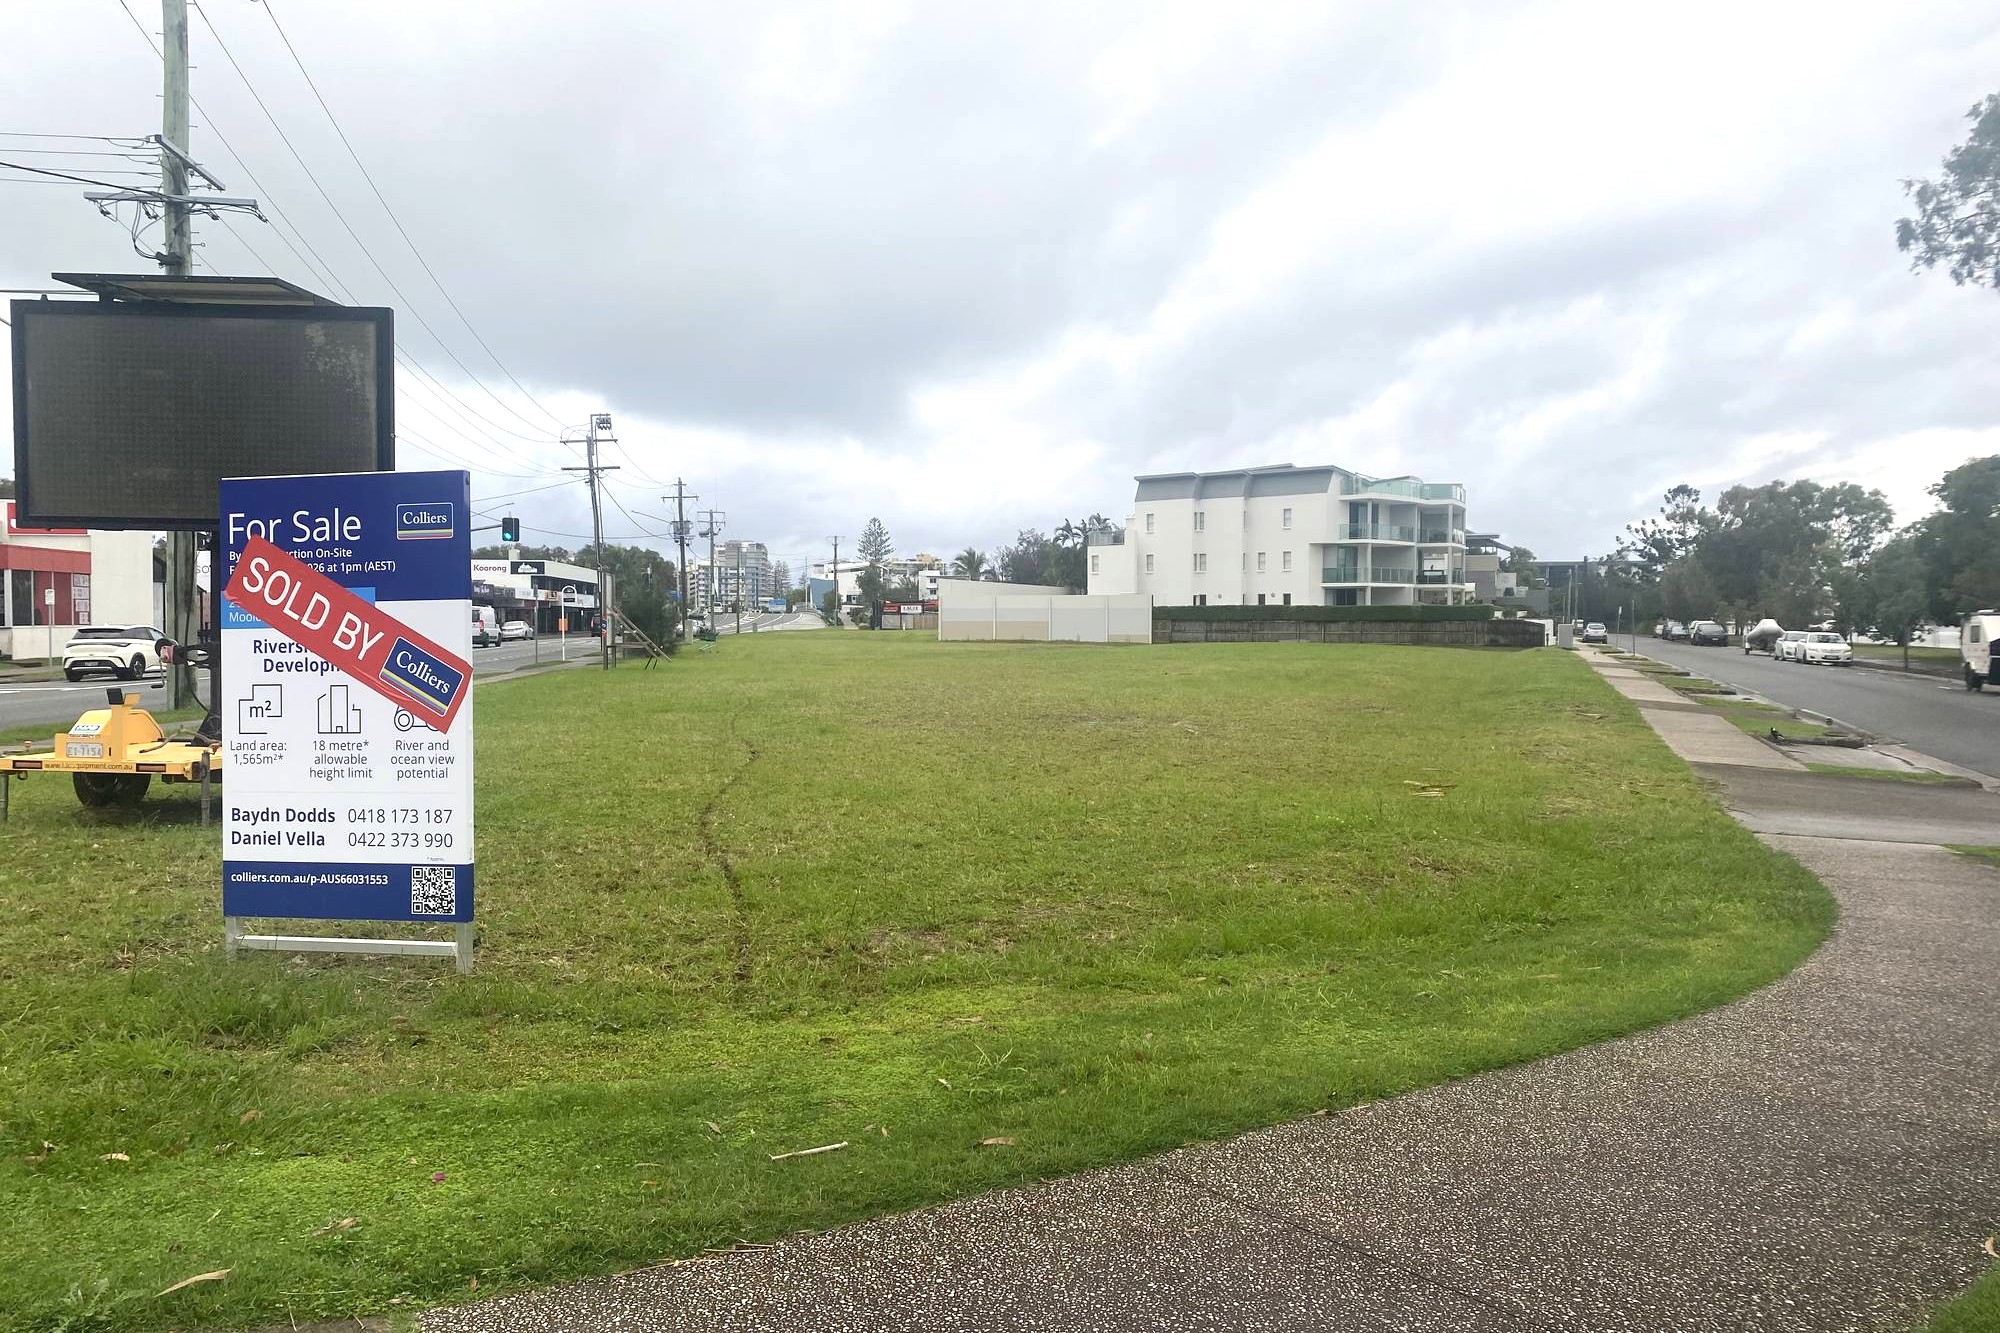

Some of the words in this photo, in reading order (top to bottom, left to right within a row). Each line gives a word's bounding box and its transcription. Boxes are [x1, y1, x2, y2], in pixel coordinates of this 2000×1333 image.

[403, 511, 447, 525] Colliers
[229, 513, 282, 544] For
[292, 508, 361, 542] Sale
[229, 551, 241, 563] By
[316, 548, 353, 558] On-Site
[327, 563, 338, 572] at
[340, 563, 362, 574] 1pm
[365, 561, 396, 573] (AEST)
[473, 564, 507, 573] Koorong
[243, 557, 330, 631] SOLD
[332, 611, 385, 660] BY
[253, 639, 310, 653] Rivers
[263, 657, 340, 676] Develop
[396, 651, 451, 694] Colliers
[230, 740, 257, 751] Land
[259, 742, 287, 751] area:
[312, 740, 326, 751] 18
[395, 740, 424, 751] River
[427, 739, 450, 751] and
[314, 753, 368, 765] allowable
[390, 755, 425, 765] ocean
[428, 754, 455, 765] view
[309, 767, 345, 781] height
[348, 767, 373, 778] limit
[396, 767, 448, 781] potential
[231, 807, 280, 826] Baydn
[285, 808, 335, 823] Dodds
[348, 808, 386, 823] 0418
[391, 809, 419, 823] 173
[424, 809, 453, 824] 187
[231, 831, 281, 845] Daniel
[285, 831, 325, 846] Vella
[348, 832, 386, 847] 0422
[390, 832, 419, 847] 373
[424, 833, 453, 848] 990
[231, 871, 389, 886] colliers.com.au/p-AUS66031553
